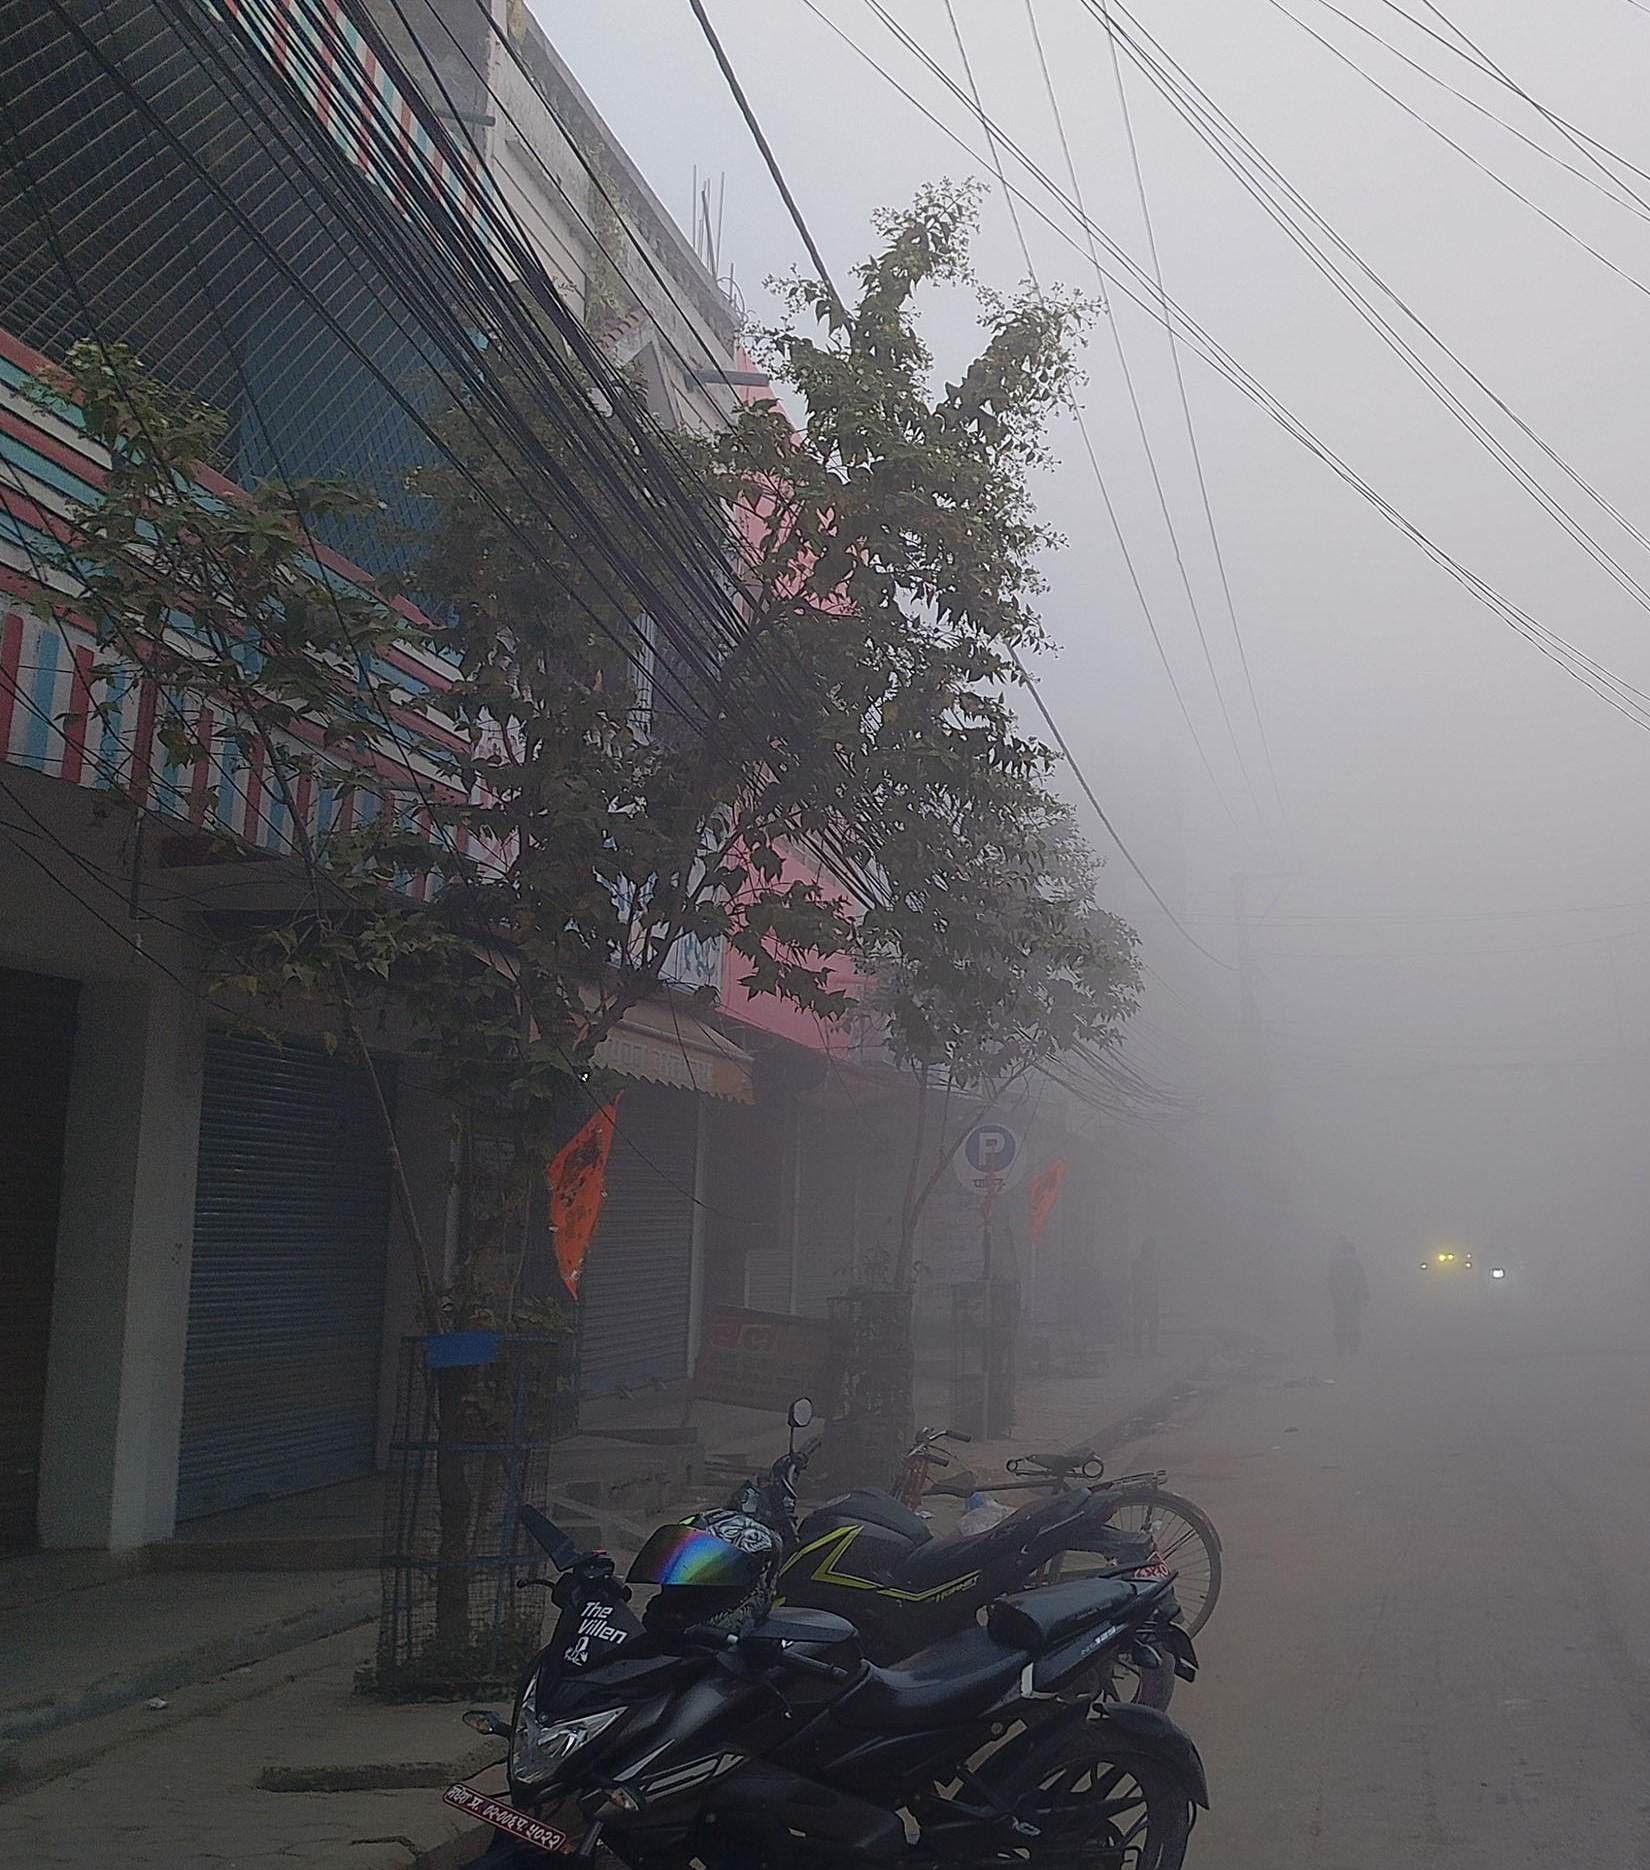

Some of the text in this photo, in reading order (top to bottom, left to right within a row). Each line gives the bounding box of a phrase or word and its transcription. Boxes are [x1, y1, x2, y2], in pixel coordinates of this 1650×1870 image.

[979, 1132, 1006, 1166] P
[581, 1601, 614, 1618] The
[577, 1618, 629, 1645] Villen
